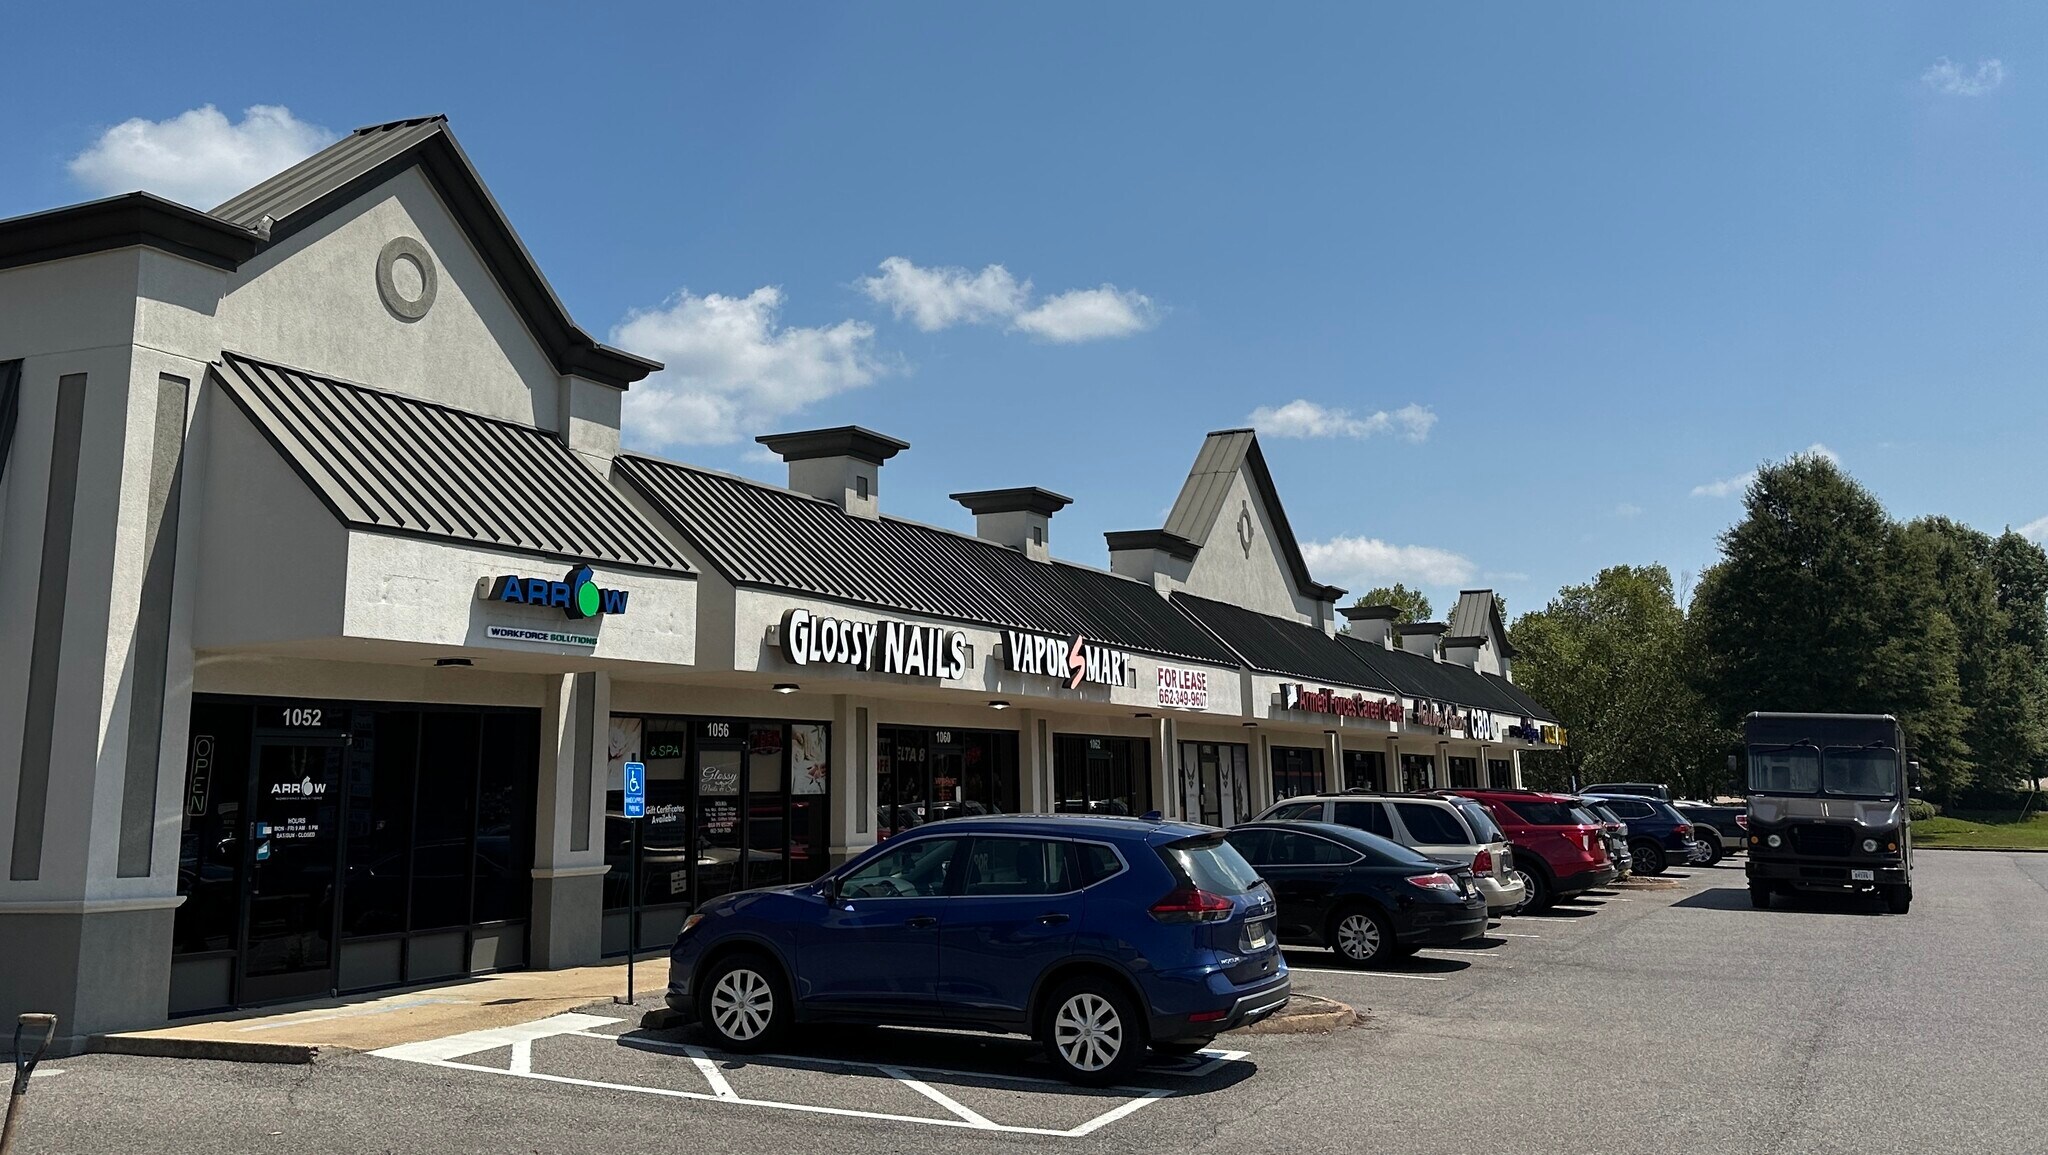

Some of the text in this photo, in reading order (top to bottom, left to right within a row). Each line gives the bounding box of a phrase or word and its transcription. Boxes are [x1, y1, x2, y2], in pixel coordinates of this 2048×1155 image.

[498, 563, 629, 619] ARROW
[490, 628, 598, 646] WORKFORCE SOLUTIONS
[788, 608, 967, 681] GLOSSY NAILS
[1007, 629, 1071, 679] VAPOR
[1157, 667, 1208, 692] FOR LEASE
[1158, 690, 1208, 708] 662-349-9607
[1300, 686, 1329, 714] Armed
[1328, 691, 1357, 718] Forces
[1357, 693, 1381, 720] Career
[282, 708, 322, 726] 1052
[1470, 707, 1490, 741] CBD
[707, 722, 729, 738] 1056
[935, 730, 952, 744] 1060
[658, 744, 680, 757] SPA
[918, 747, 926, 763] 8
[190, 738, 211, 814] OPEN
[701, 766, 738, 786] Glossy
[271, 776, 327, 797] ARROW
[645, 803, 685, 815] Gift Certificates
[651, 813, 677, 825] Available
